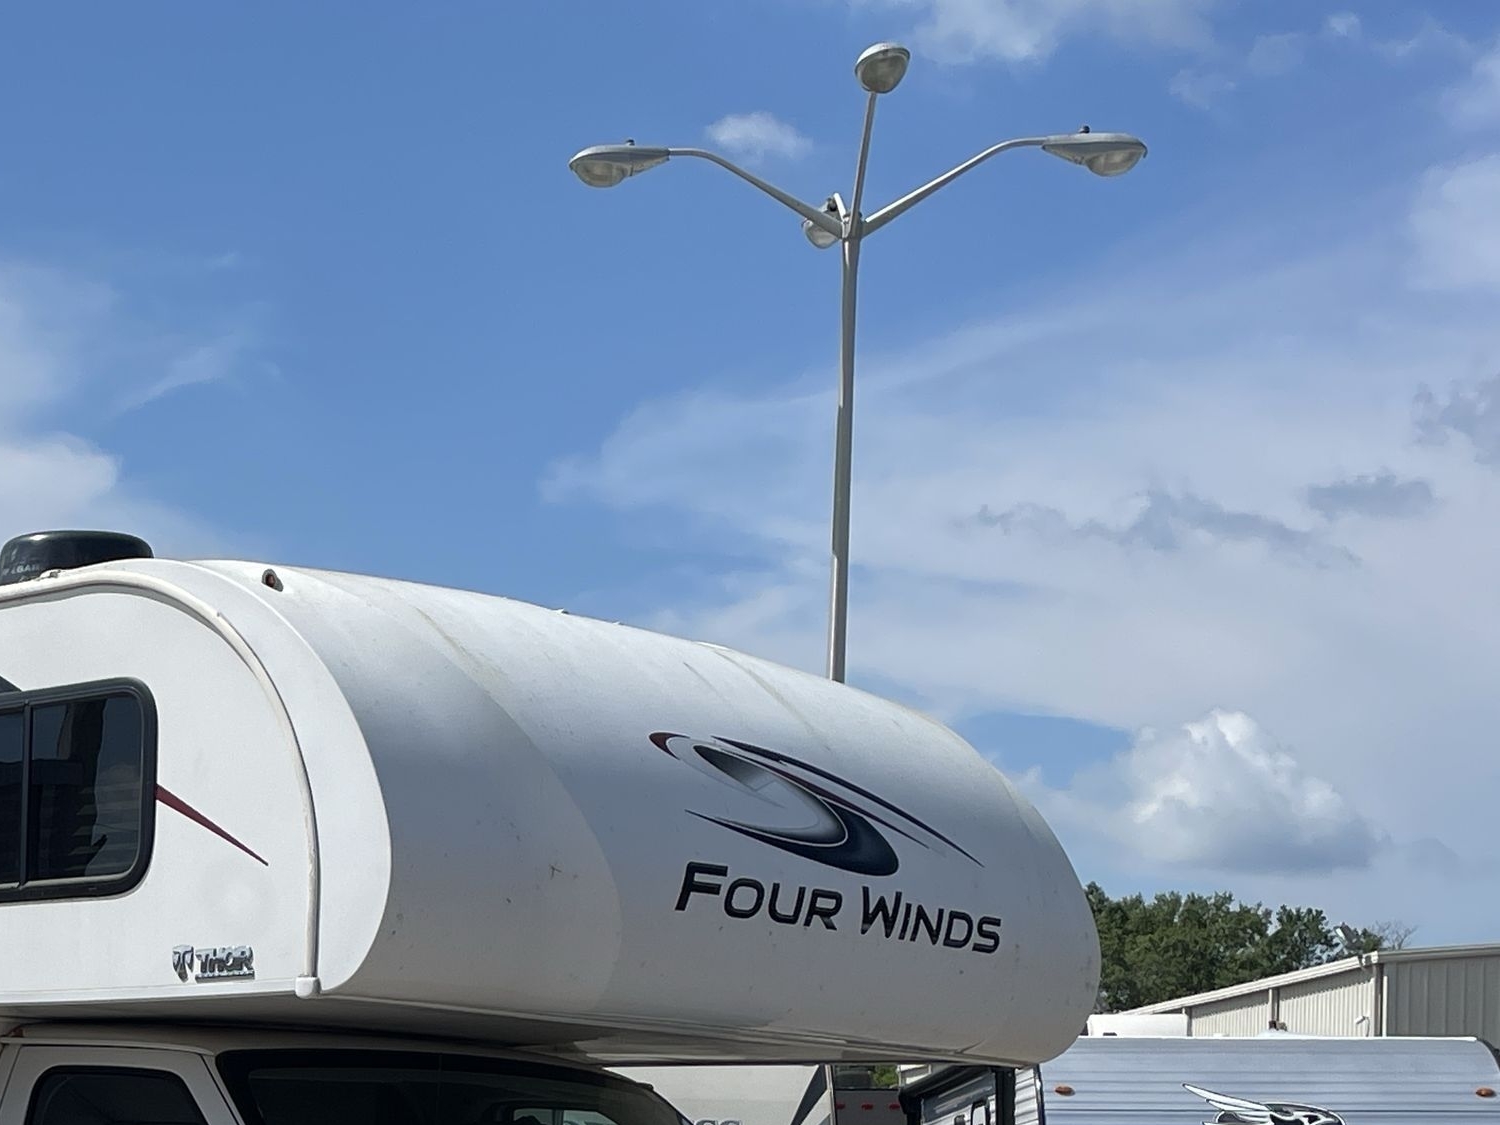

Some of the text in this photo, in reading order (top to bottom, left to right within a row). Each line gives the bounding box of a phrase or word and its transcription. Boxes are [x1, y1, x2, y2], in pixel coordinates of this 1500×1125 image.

[674, 861, 1002, 954] FOUR WINDS
[195, 946, 254, 974] THOR
